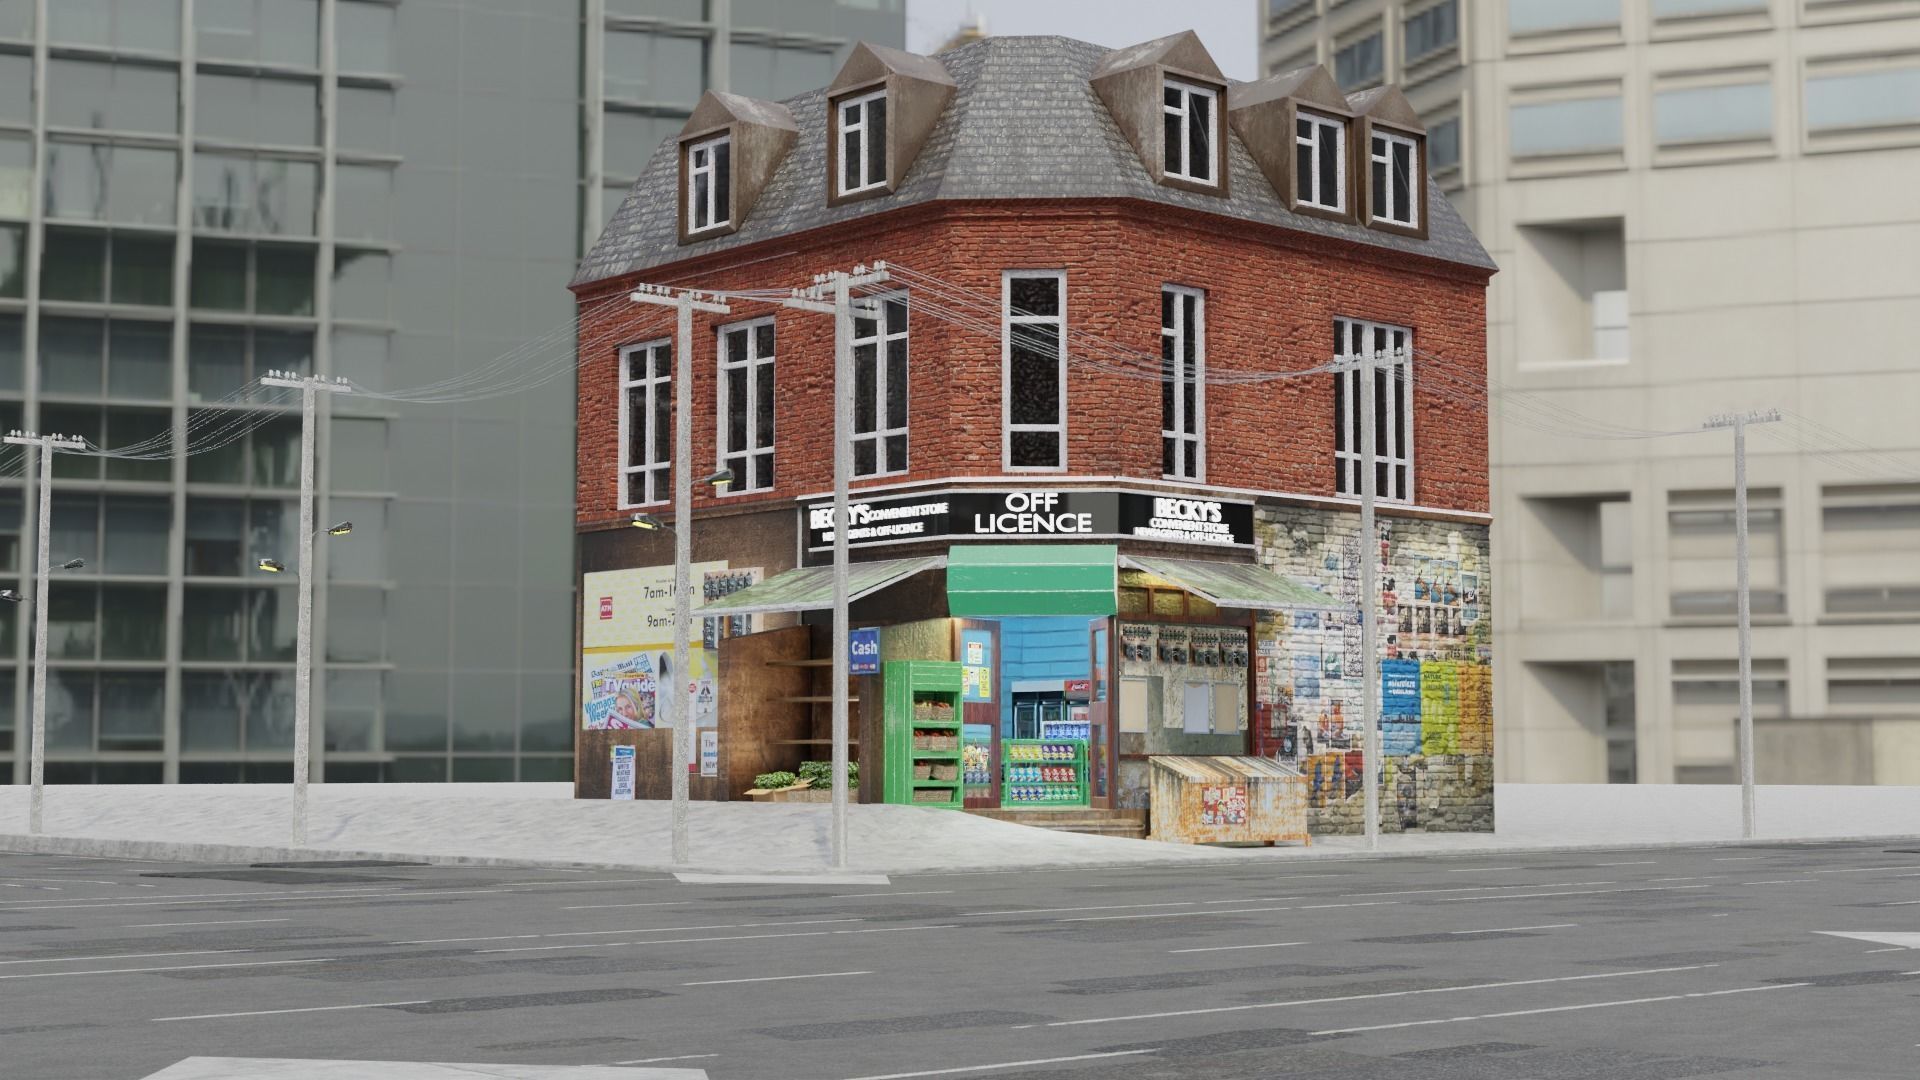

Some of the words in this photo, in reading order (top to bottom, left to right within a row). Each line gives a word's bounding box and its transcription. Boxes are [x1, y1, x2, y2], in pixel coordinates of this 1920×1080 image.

[1005, 492, 1058, 512] OFF
[975, 513, 1092, 533] LICENCE
[851, 640, 878, 655] Cash
